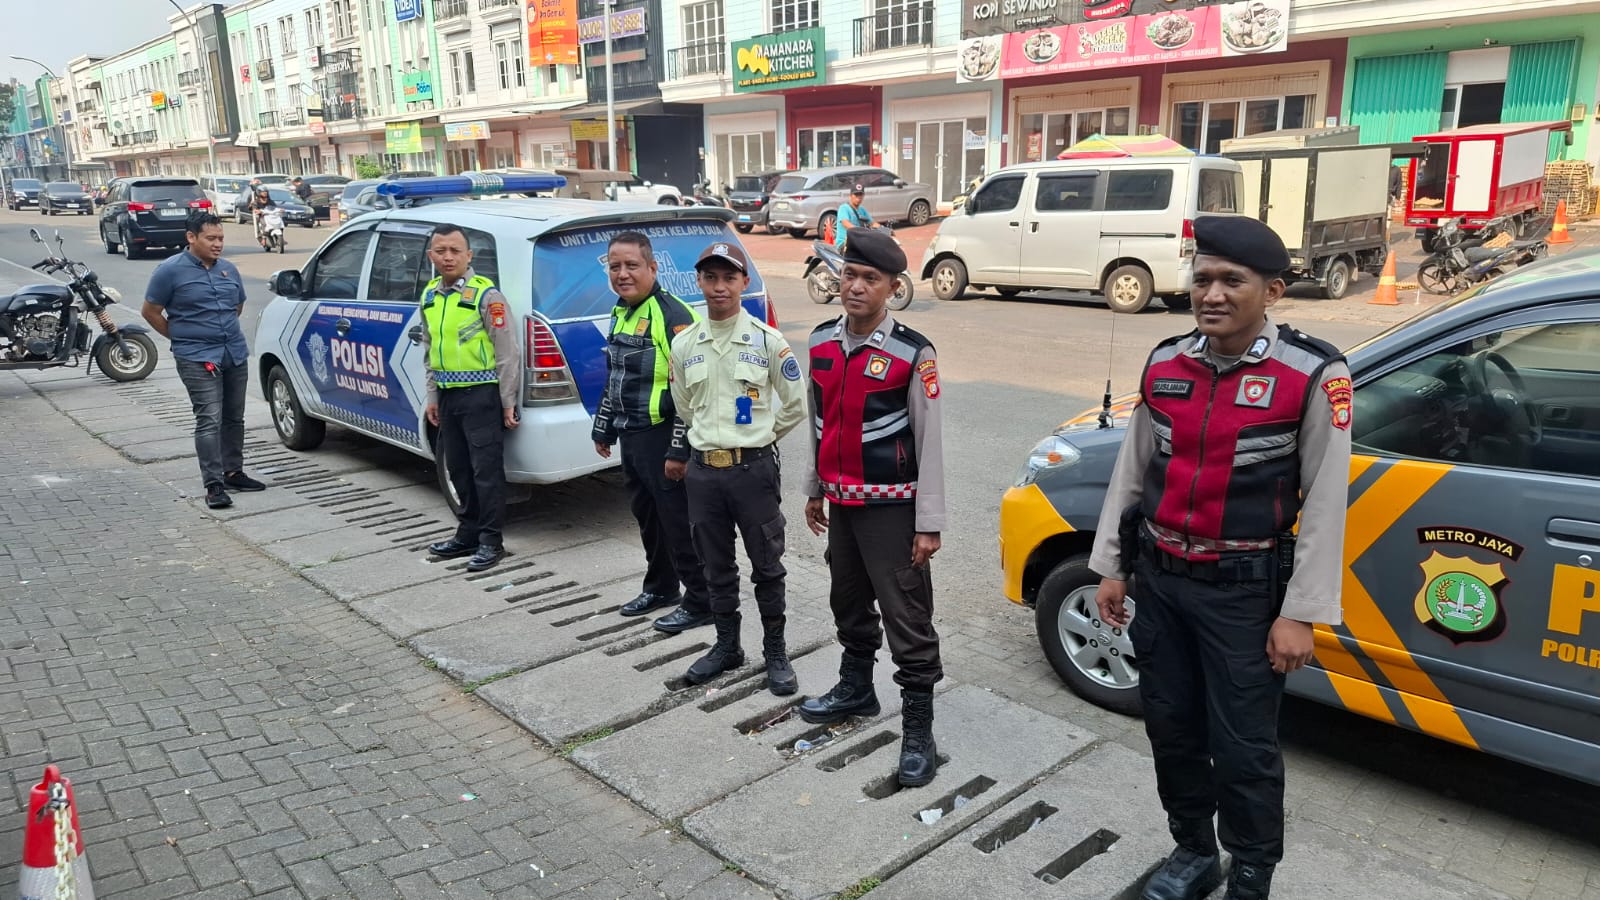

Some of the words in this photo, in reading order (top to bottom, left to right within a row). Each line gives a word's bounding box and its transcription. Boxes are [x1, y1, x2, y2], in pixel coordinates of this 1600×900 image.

[973, 2, 998, 20] KOPI
[1003, 0, 1057, 15] SEWINDU
[756, 38, 814, 59] MAMANARA
[769, 54, 814, 72] KITCHEN
[559, 232, 587, 248] UNIT
[669, 225, 706, 238] KELAPA
[704, 224, 723, 236] DUA
[330, 338, 385, 378] POLISI
[335, 373, 356, 391] LALU
[356, 378, 389, 399] LINTAS
[1424, 530, 1476, 544] METRO
[1478, 536, 1513, 556] JAYA
